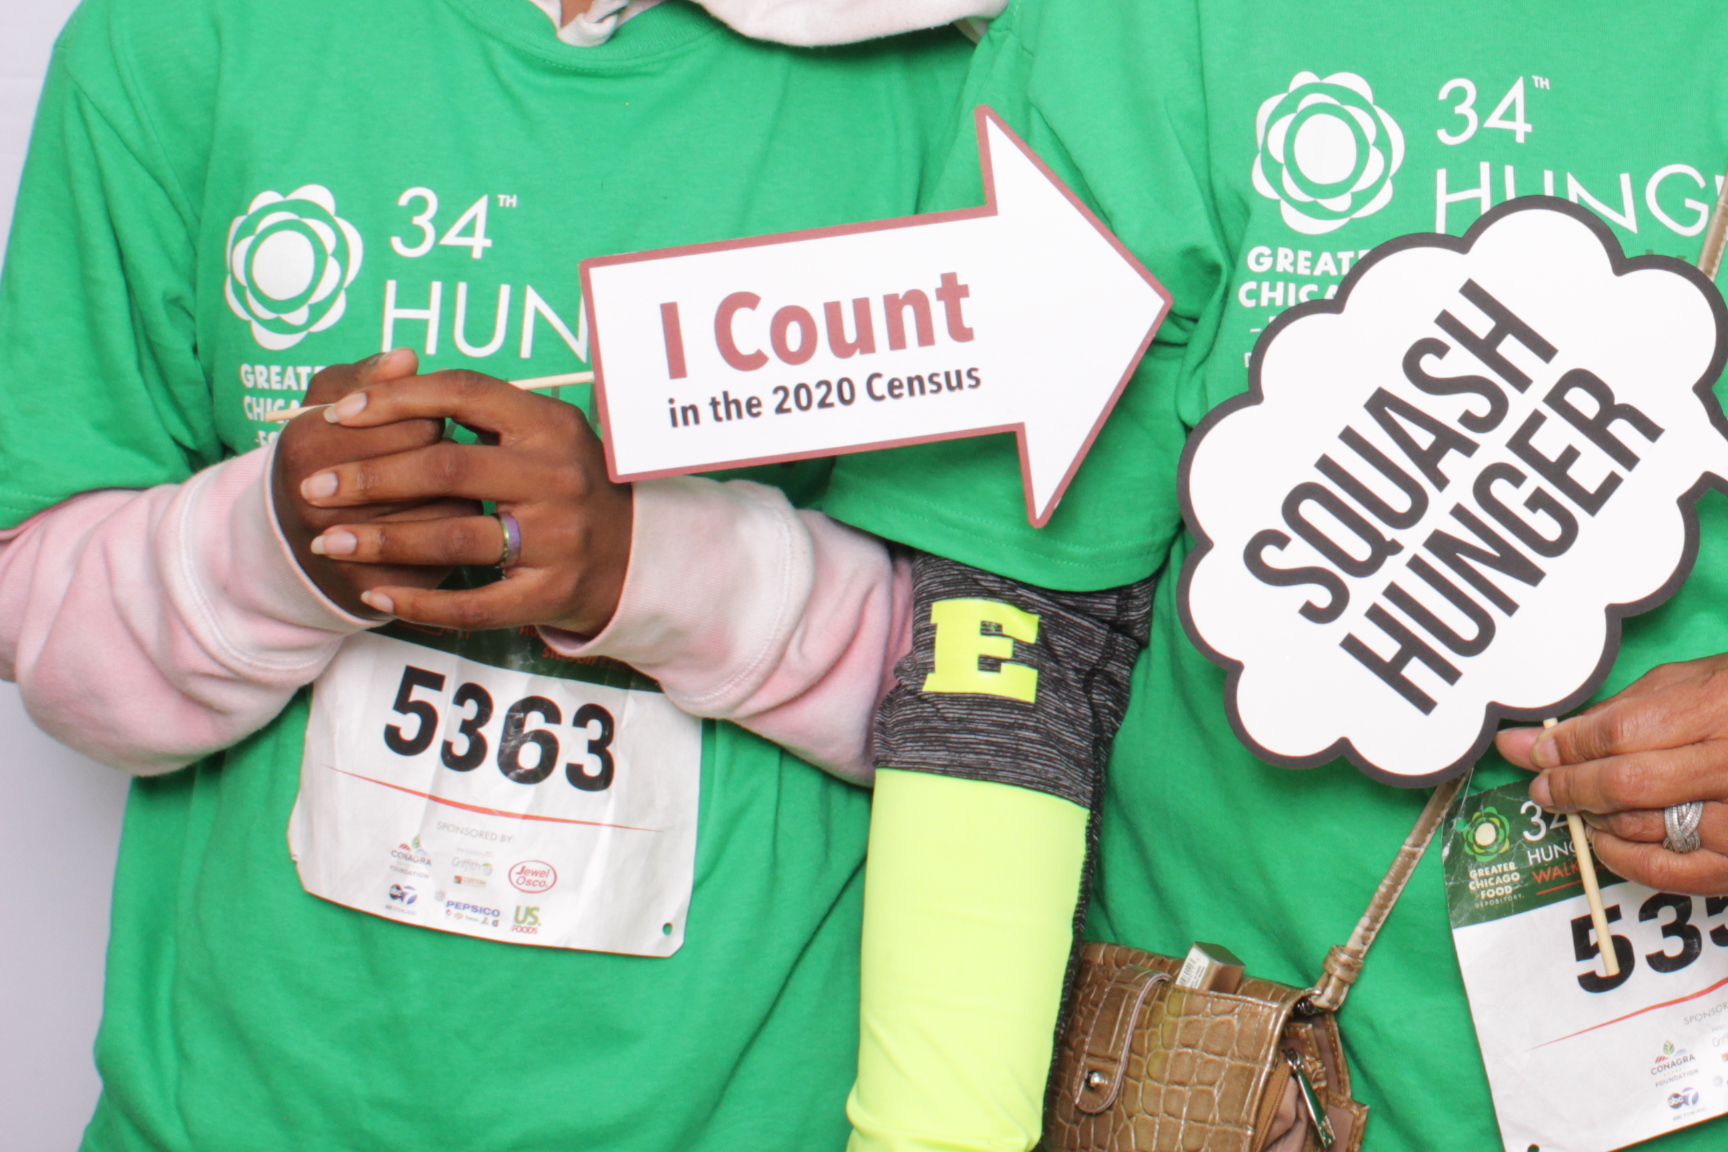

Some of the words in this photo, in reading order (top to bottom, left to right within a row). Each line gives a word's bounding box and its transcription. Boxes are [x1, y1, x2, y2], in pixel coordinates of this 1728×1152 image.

[1247, 245, 1371, 276] GREAT
[381, 279, 590, 362] HUN
[659, 301, 688, 380] I
[713, 271, 975, 373] Count
[239, 363, 327, 391] GREAT
[667, 397, 700, 428] in
[709, 390, 763, 422] the
[772, 377, 857, 415] 2020
[866, 366, 982, 402] Census
[1243, 277, 1560, 625] SQUASH
[1338, 367, 1666, 717] HUNGER
[921, 597, 1040, 704] E
[383, 664, 616, 792] 5363
[436, 821, 498, 841] SPONSORED
[390, 849, 432, 866] CONAGRA
[515, 865, 551, 878] Jewel
[1468, 872, 1521, 891] CHICAGO
[1469, 862, 1516, 879] GREATER
[1480, 885, 1513, 900] FOOD
[446, 900, 501, 918] PEPSICO
[511, 925, 538, 935] FOODS
[1650, 1054, 1696, 1076] CONAGRA
[1655, 1068, 1699, 1088] FOUNDATION
